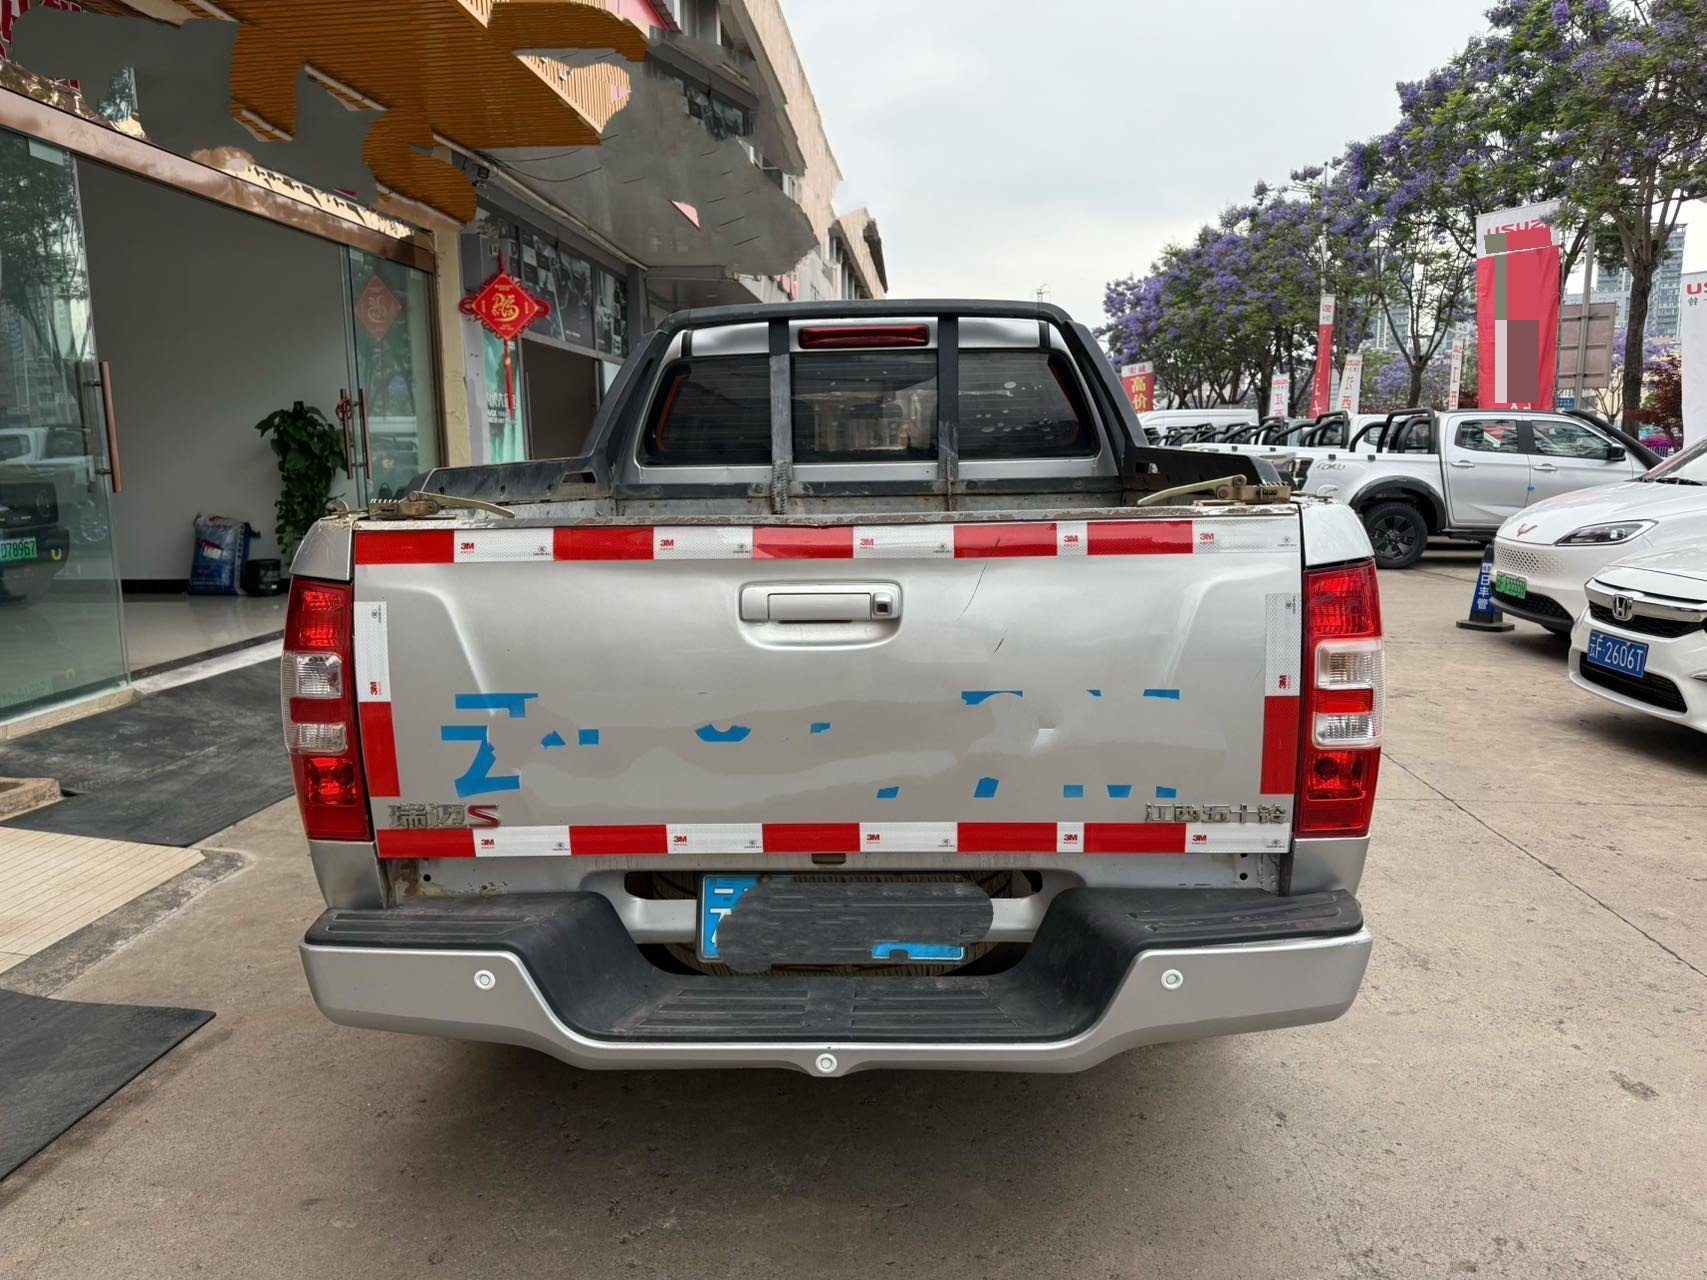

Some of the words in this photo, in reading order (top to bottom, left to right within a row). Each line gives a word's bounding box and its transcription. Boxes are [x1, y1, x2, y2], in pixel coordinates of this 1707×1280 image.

[1064, 535, 1078, 543] 3M
[1199, 533, 1214, 541] 3M
[860, 538, 874, 546] 3M
[370, 681, 378, 695] 3M
[1192, 834, 1207, 842] 3M
